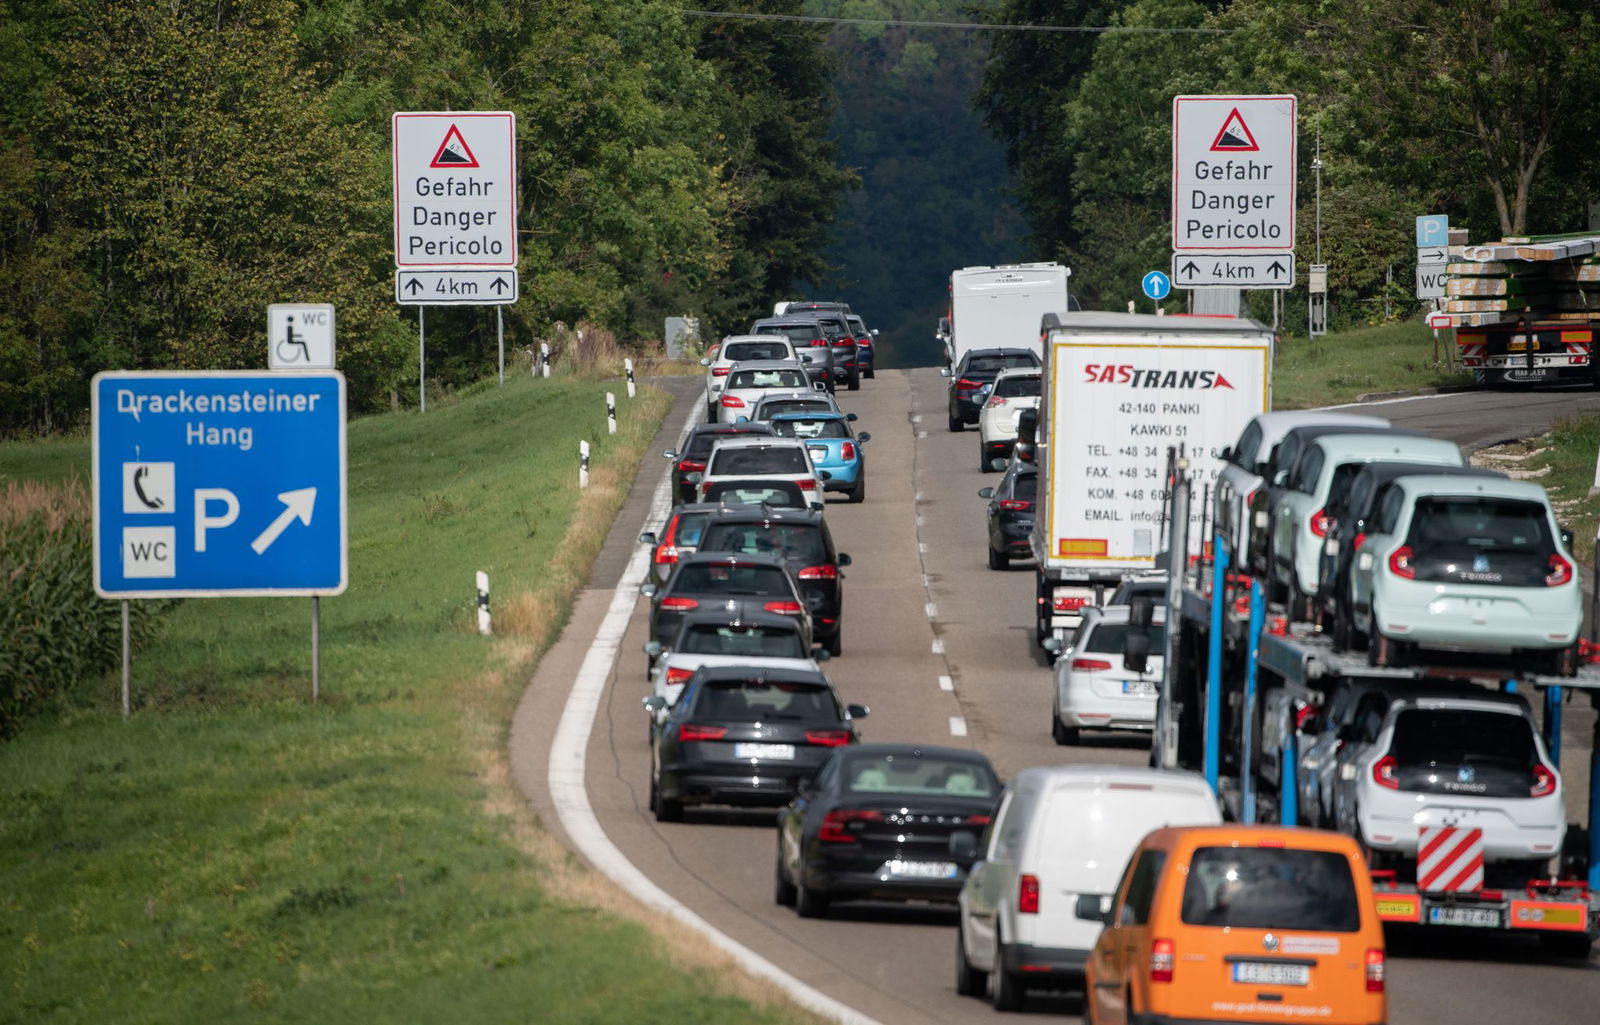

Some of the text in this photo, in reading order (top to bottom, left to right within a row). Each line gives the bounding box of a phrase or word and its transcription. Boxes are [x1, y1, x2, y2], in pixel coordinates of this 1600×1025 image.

[1195, 160, 1273, 180] Gefahr
[416, 177, 493, 196] Gefahr
[1191, 190, 1275, 214] Danger
[413, 206, 497, 231] Danger
[1187, 219, 1281, 239] Pericolo
[1423, 219, 1440, 243] P
[409, 236, 502, 255] Pericolo
[1421, 273, 1448, 288] WC
[302, 312, 328, 326] WC
[117, 388, 321, 414] Drackensteiner
[1118, 403, 1200, 415] 42-140 PANKI
[186, 422, 253, 451] Hang
[1131, 425, 1188, 437] KAWKI 51
[1088, 445, 1112, 457] TEL.
[1119, 446, 1138, 458] +48
[1145, 446, 1158, 458] 34
[1192, 447, 1204, 459] 17
[1086, 467, 1112, 478] FAX.
[1119, 467, 1138, 479] +48
[1145, 467, 1158, 479] 34
[1192, 468, 1204, 480] 17
[1087, 488, 1118, 500] KOM.
[1125, 489, 1144, 501] +48
[194, 488, 240, 552] P
[1085, 510, 1124, 521] EMAIL.
[131, 542, 168, 561] WC
